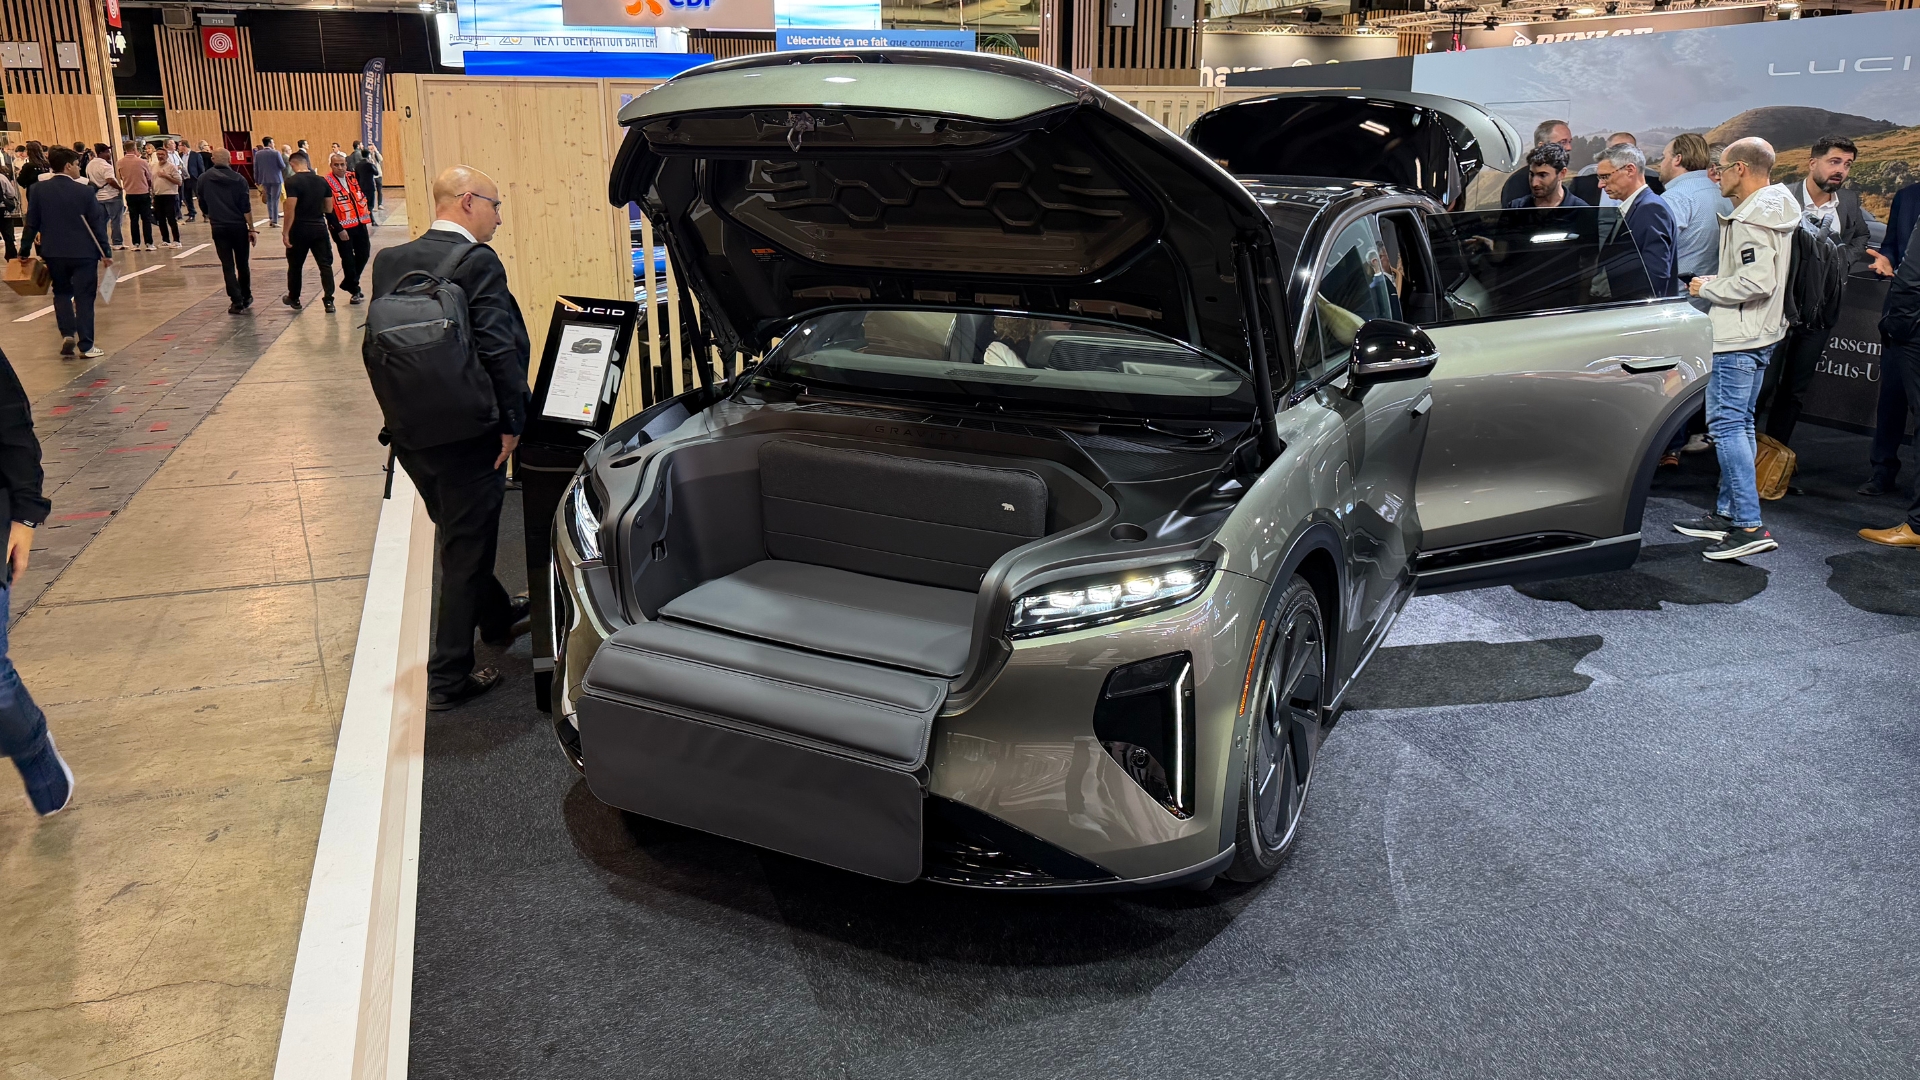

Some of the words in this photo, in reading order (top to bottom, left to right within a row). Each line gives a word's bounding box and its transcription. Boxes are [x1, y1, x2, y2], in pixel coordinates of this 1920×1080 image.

[533, 36, 559, 46] NEXT
[563, 37, 623, 47] GENERATION
[625, 38, 658, 48] BATTERY
[843, 38, 855, 47] ça
[856, 38, 869, 46] ne
[870, 36, 888, 47] fait
[889, 39, 908, 48] que
[909, 39, 965, 48] commencer
[1767, 55, 1912, 76] LUCI
[564, 304, 626, 317] LUCID
[1829, 336, 1882, 356] assem
[1815, 350, 1881, 382] États-U
[874, 425, 960, 440] GRAVITY
